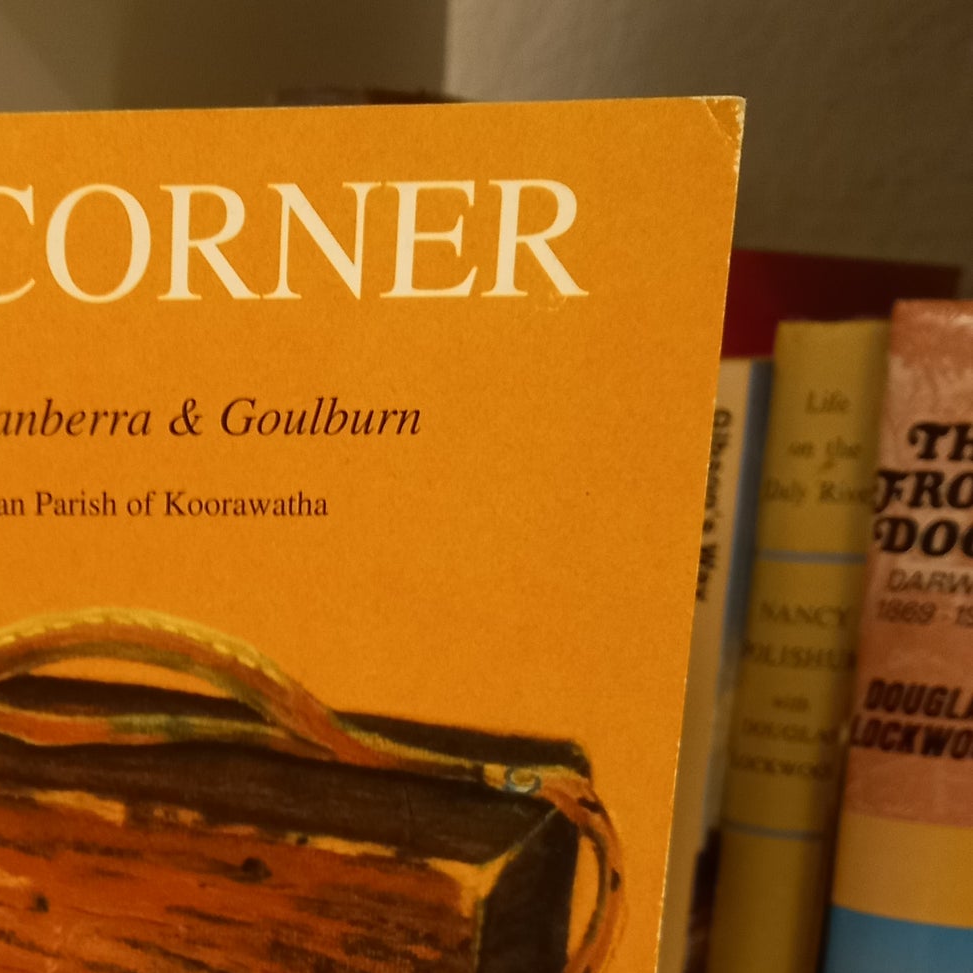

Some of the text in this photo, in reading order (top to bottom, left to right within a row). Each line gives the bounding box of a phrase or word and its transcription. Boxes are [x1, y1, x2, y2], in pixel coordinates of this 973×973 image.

[169, 398, 203, 436] &
[220, 397, 421, 437] Goulburn
[35, 491, 118, 517] Parish
[126, 491, 155, 516] of
[164, 491, 328, 517] Koorawatha
